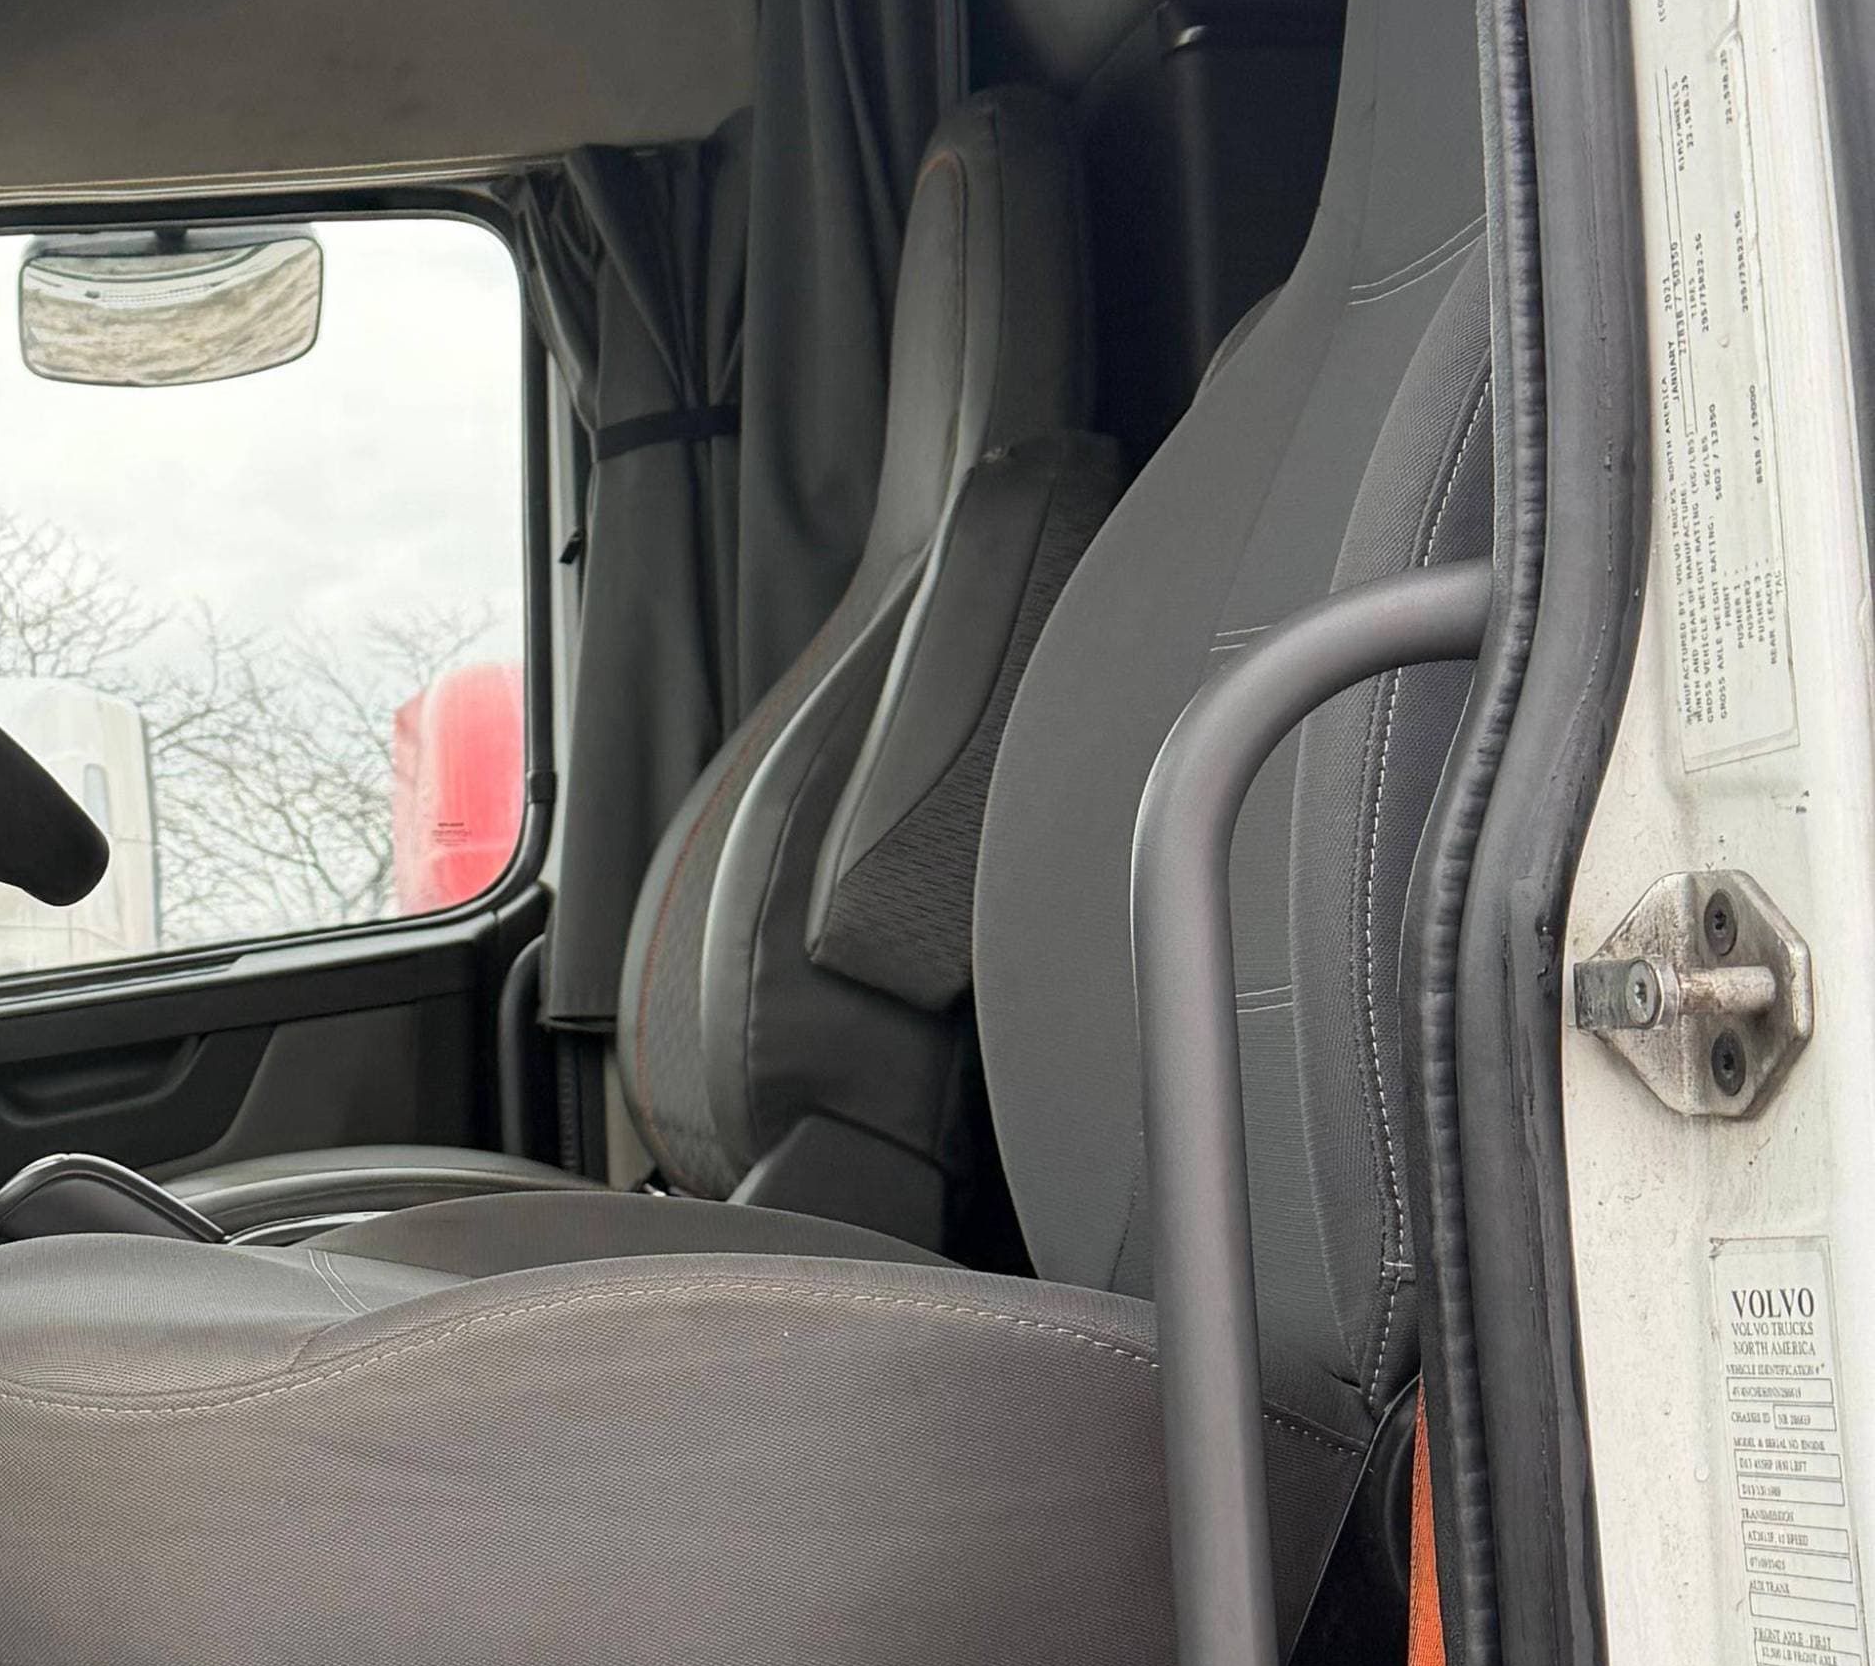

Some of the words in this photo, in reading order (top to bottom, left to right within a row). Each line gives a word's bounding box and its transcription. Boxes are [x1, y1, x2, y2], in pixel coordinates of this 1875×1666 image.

[1660, 376, 1672, 434] AMERICA
[1665, 439, 1676, 480] NORTH
[1670, 488, 1679, 537] TRUCKS
[1673, 543, 1684, 585] VOLVO
[1732, 1288, 1814, 1319] VOLVO
[1731, 1322, 1769, 1336] VOLVO
[1771, 1321, 1814, 1336] TRUCKS
[1733, 1341, 1767, 1355] NORTH
[1772, 1341, 1816, 1355] AMERICA
[1782, 1630, 1804, 1646] AXLE
